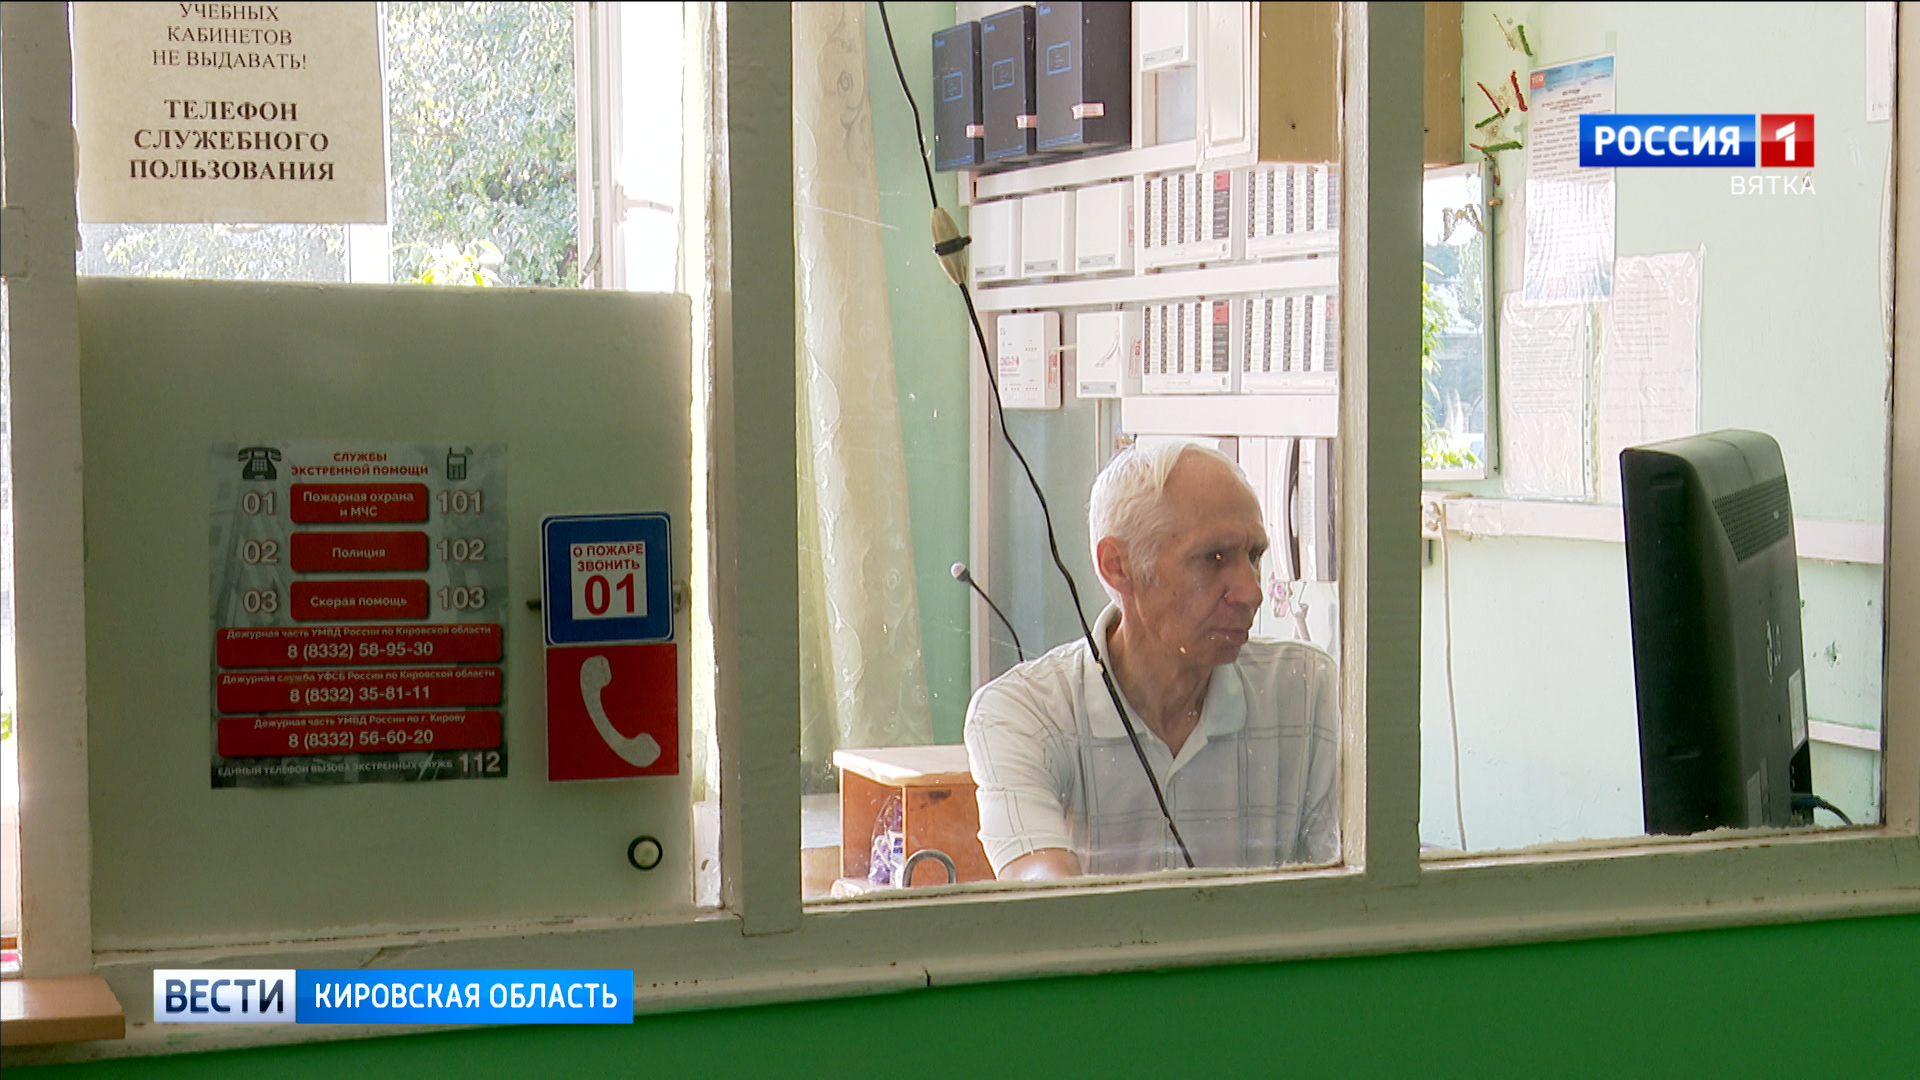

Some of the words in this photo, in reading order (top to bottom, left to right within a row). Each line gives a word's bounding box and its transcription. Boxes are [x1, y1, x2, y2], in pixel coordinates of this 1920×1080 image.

[180, 3, 279, 22] УЧЕБНЫХ
[168, 26, 292, 46] КАБИНЕТОВ
[152, 50, 180, 66] НЕ
[187, 51, 307, 70] ВЫДАВАТЬ!
[164, 99, 297, 121] ТЕЛЕФОН
[133, 129, 329, 152] СЛУЖЕБНОГО
[129, 159, 334, 181] ПОЛЬЗОВАНИЯ
[333, 452, 388, 463] СЛУЖБЫ
[291, 464, 370, 476] ЭКСТРЕННОЙ
[373, 465, 429, 477] ПОМОЩИ
[242, 491, 275, 515] 01
[303, 491, 368, 505] Пожарная
[370, 492, 414, 504] охрана
[437, 489, 483, 514] 101
[340, 508, 348, 517] и
[350, 506, 378, 517] МЧС
[242, 540, 279, 565] 02
[332, 547, 386, 559] Полиция
[437, 538, 486, 562] 102
[573, 546, 583, 557] О
[586, 544, 644, 556] ПОЖАРЕ
[577, 559, 640, 572] ЗВОНИТЬ
[242, 590, 279, 614] 03
[310, 596, 356, 608] Скорая
[359, 596, 408, 607] помощь
[437, 586, 486, 610] 103
[584, 573, 635, 615] 01
[226, 629, 280, 640] Дежурная
[281, 630, 309, 638] часть
[343, 628, 380, 637] России
[395, 626, 449, 637] Кировской
[451, 626, 492, 634] области
[287, 643, 298, 659] 8
[302, 643, 354, 661] (8332)
[358, 641, 434, 657] 58-95-30
[222, 674, 275, 685] Дежурная
[347, 671, 384, 680] России
[399, 670, 453, 681] Кировской
[455, 669, 495, 678] области
[289, 687, 300, 704] 8
[304, 687, 354, 705] (8332)
[358, 685, 430, 702] 35-81-11
[253, 718, 306, 730] Дежурная
[308, 718, 335, 726] часть
[369, 715, 406, 724] России
[430, 713, 466, 724] Кирову
[288, 733, 299, 748] 8
[303, 731, 354, 750] (8332)
[359, 729, 434, 746] 56-60-20
[217, 766, 262, 776] ЕДИНЫЙ
[263, 765, 309, 774] ТЕЛЕФОН
[458, 751, 502, 774] 112
